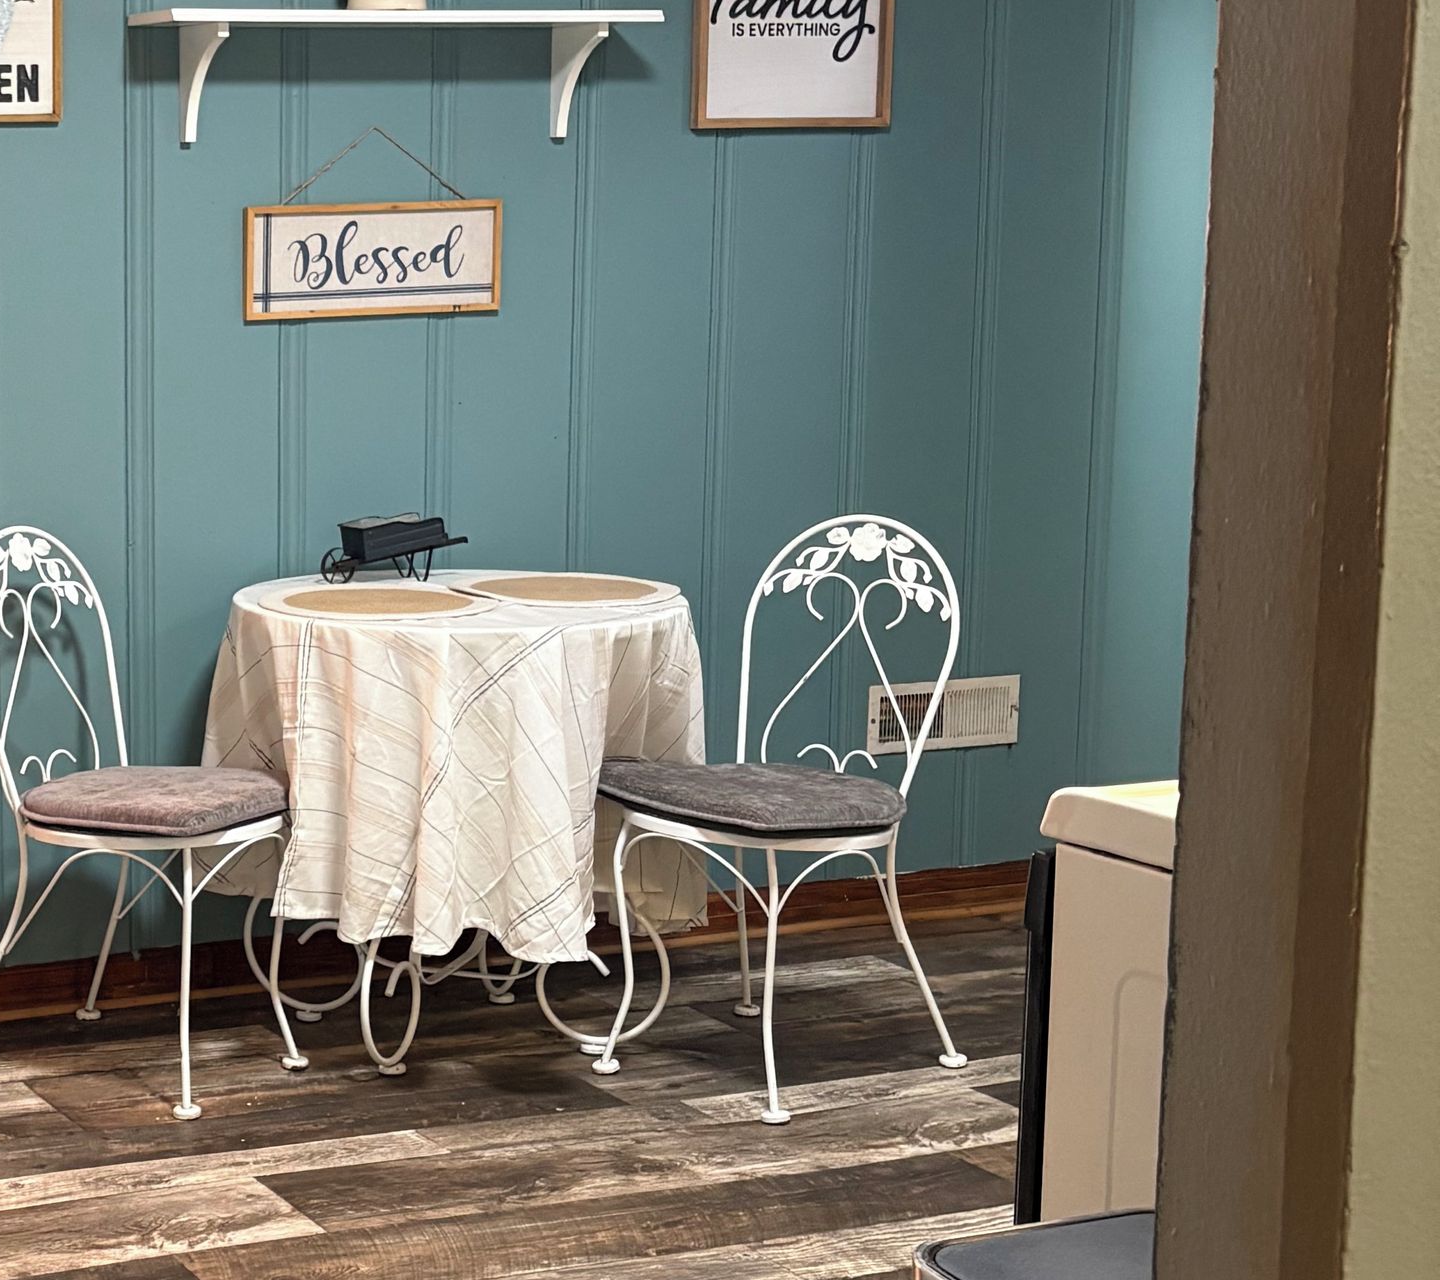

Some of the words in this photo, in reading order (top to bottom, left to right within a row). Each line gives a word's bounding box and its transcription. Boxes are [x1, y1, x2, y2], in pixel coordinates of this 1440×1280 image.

[731, 23, 745, 37] IS
[749, 23, 841, 37] EVERYTHING
[287, 220, 464, 290] Blessed
